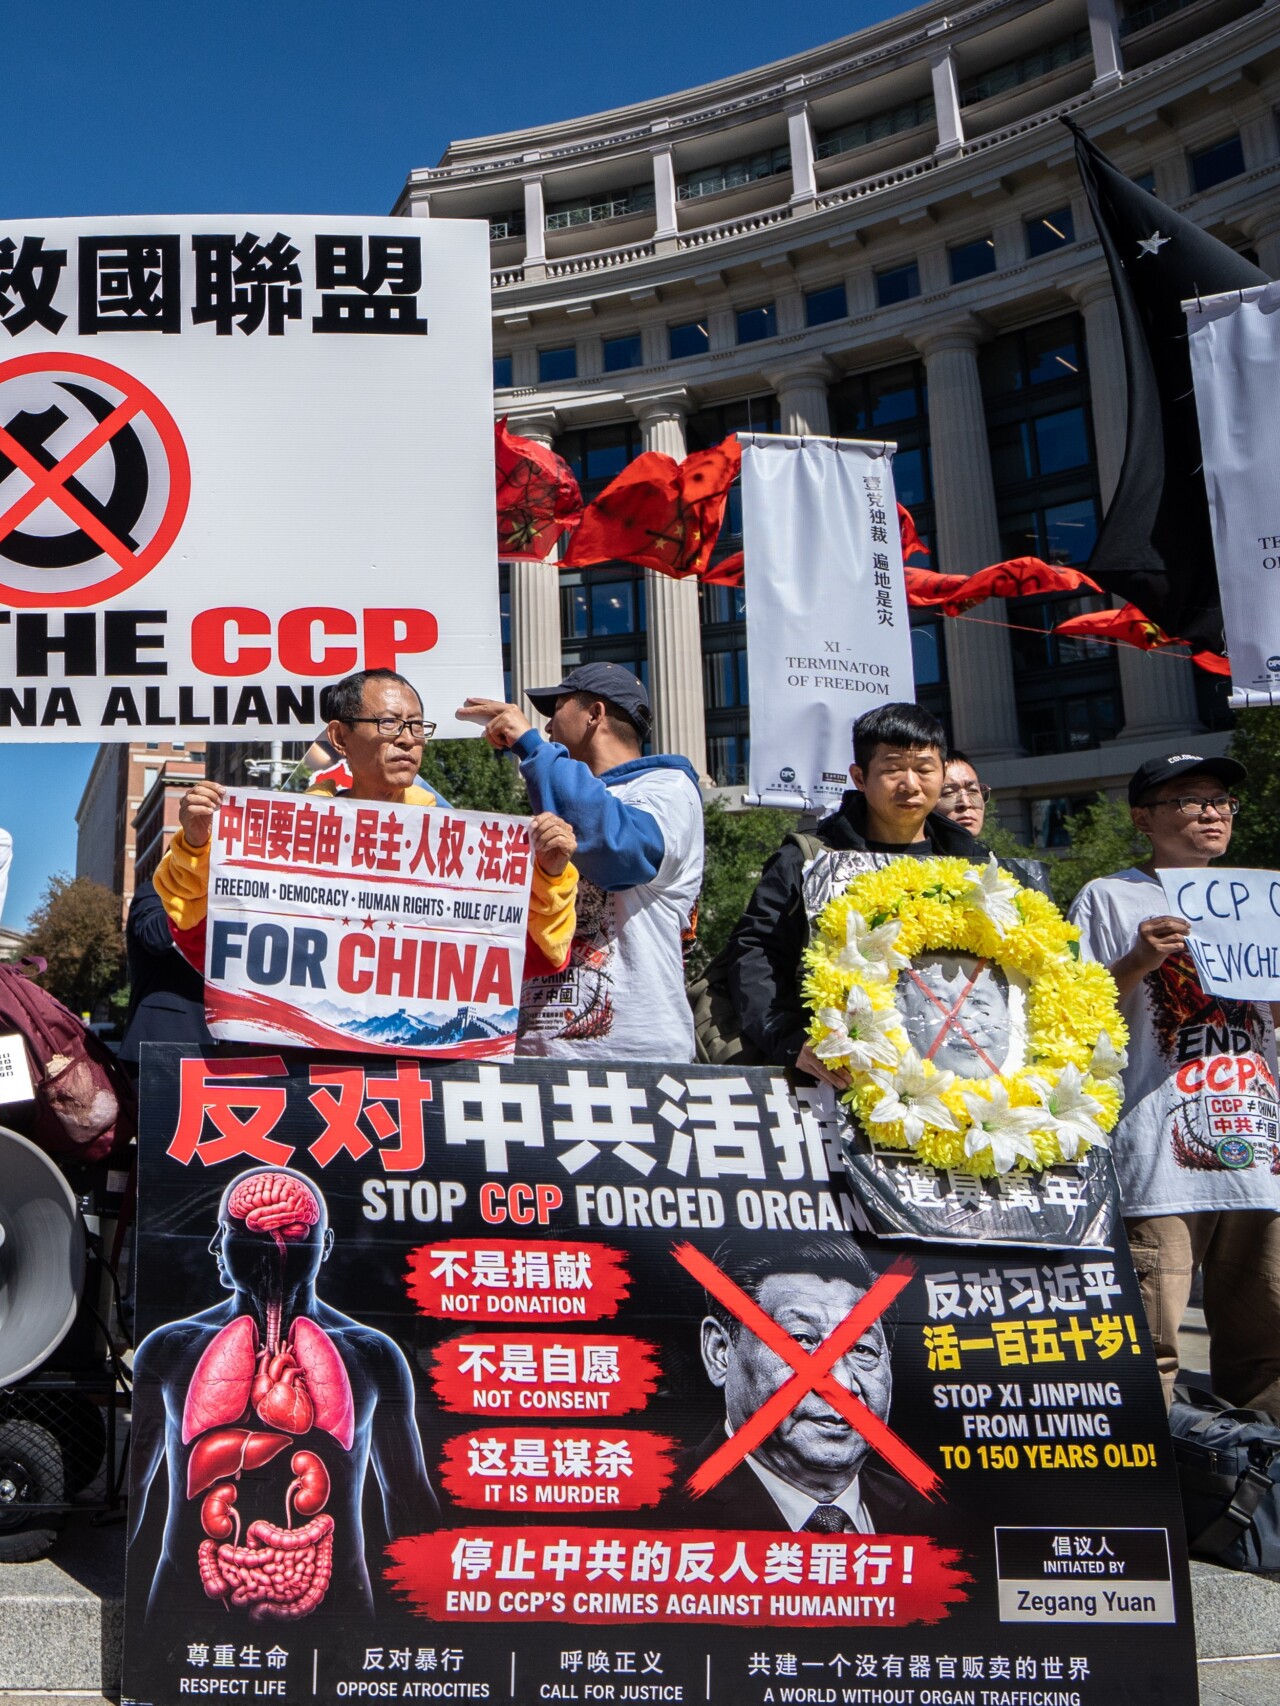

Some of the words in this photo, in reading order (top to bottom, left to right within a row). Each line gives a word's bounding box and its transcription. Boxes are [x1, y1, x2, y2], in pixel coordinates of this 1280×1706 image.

[863, 476, 888, 544] 壹党独裁
[872, 552, 894, 627] 遍地是灾
[189, 606, 439, 679] CCP
[824, 641, 840, 653] XI
[785, 657, 890, 678] TERMINATOR
[787, 675, 809, 687] OF
[814, 676, 890, 695] FREEDOM
[100, 685, 337, 727] ALLIAN
[214, 877, 270, 899] FREEDOM
[279, 883, 349, 907] DEMOCRACY
[358, 891, 400, 911] HUMAN
[403, 894, 444, 917] RIGHTS
[454, 901, 479, 920] RULE
[482, 904, 497, 922] OF
[499, 906, 523, 924] LAW
[1177, 880, 1250, 922] CCP
[210, 920, 328, 990] FOR
[337, 932, 515, 1007] CHINA
[1177, 1025, 1251, 1062] END
[1175, 1055, 1256, 1094] CCP
[1211, 1098, 1243, 1113] CCP
[362, 1181, 466, 1223] STOP
[480, 1183, 562, 1225] CCP
[577, 1184, 725, 1230] FORCED
[735, 1189, 872, 1234] ORGAN
[429, 1250, 593, 1291] 不是捐献
[924, 1262, 1122, 1319] 反对习近平
[441, 1295, 480, 1313] NOT
[486, 1295, 586, 1315] DONATION
[457, 1343, 621, 1384] 不是自愿
[472, 1390, 513, 1408] NOT
[518, 1391, 610, 1410] CONSENT
[933, 1383, 992, 1408] STOP
[1000, 1383, 1024, 1406] XI
[1028, 1382, 1122, 1407] JINPING
[963, 1415, 1028, 1438] FROM
[1034, 1413, 1111, 1437] LIVING
[467, 1438, 634, 1479] 这是谋杀
[940, 1446, 970, 1469] TO
[977, 1445, 1017, 1468] 150
[1024, 1444, 1097, 1468] YEARS
[1104, 1443, 1156, 1468] OLD!
[484, 1484, 502, 1502] IT
[509, 1485, 528, 1503] IS
[533, 1486, 620, 1504] MURDER
[1052, 1535, 1115, 1557] 倡议人
[1043, 1560, 1104, 1574] INITIATED
[1108, 1560, 1125, 1574] BY
[446, 1591, 491, 1613] END
[572, 1592, 659, 1615] CRIMES
[665, 1594, 762, 1616] AGAINST
[771, 1594, 895, 1618] HUMANITY!
[1017, 1591, 1096, 1617] Zegang
[1102, 1591, 1156, 1613] Yuan
[186, 1643, 289, 1668] 尊重生命
[362, 1647, 464, 1671] 反对暴行
[560, 1650, 663, 1673] 呼唤正义
[748, 1653, 1091, 1680] 共建一个没有器官贩卖的世界
[180, 1679, 249, 1695] RESPECT
[254, 1679, 286, 1695] LIFE
[336, 1681, 399, 1697] OPPOSE
[403, 1681, 490, 1698] ATROCITIES
[540, 1684, 579, 1700] CALL
[584, 1684, 615, 1700] FOR
[620, 1684, 683, 1701] JUSTICE
[763, 1687, 774, 1702] A
[780, 1687, 836, 1703] WORLD
[842, 1689, 914, 1704] WITHOUT
[920, 1690, 975, 1706] ORGAN
[982, 1691, 1080, 1706] TRAFFICKING
